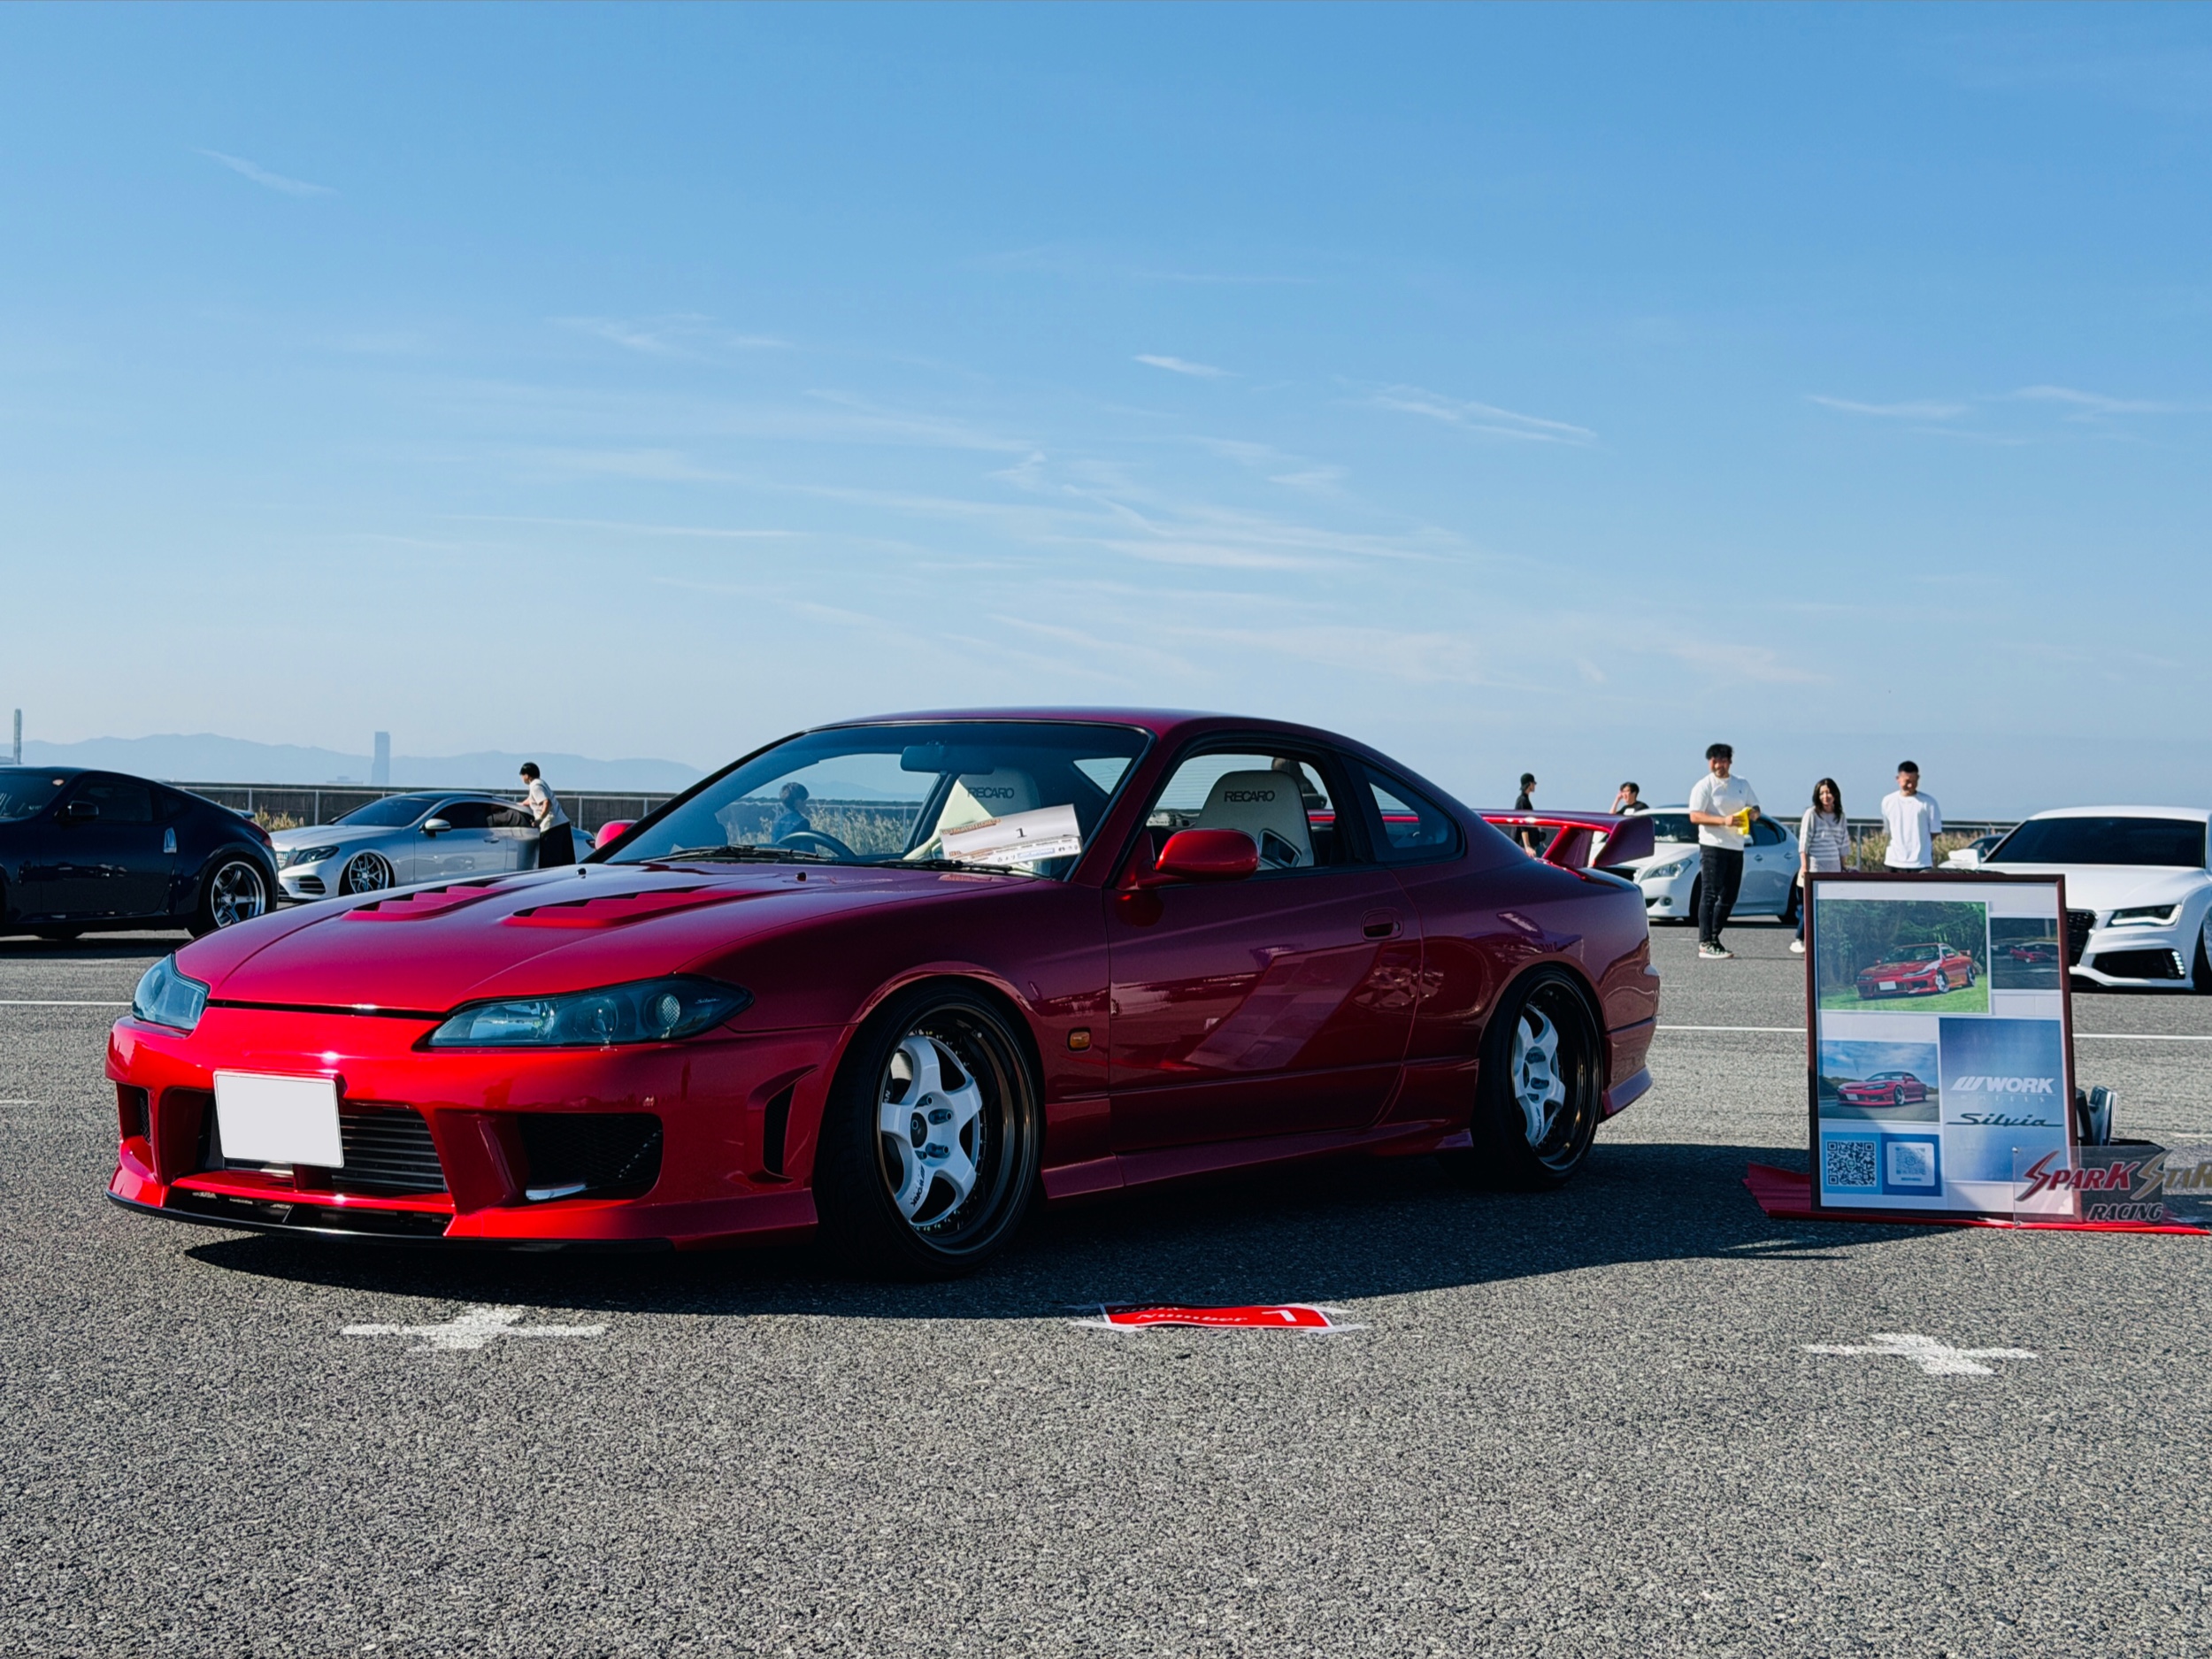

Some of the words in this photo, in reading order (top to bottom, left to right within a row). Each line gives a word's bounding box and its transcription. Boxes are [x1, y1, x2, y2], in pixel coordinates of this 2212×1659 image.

[968, 787, 1015, 799] RECARO
[1224, 790, 1276, 803] RECARO
[1016, 827, 1027, 838] 1
[1985, 1077, 2054, 1094] WORK
[1946, 1113, 2064, 1127] Silvia
[2088, 1202, 2163, 1223] RACING
